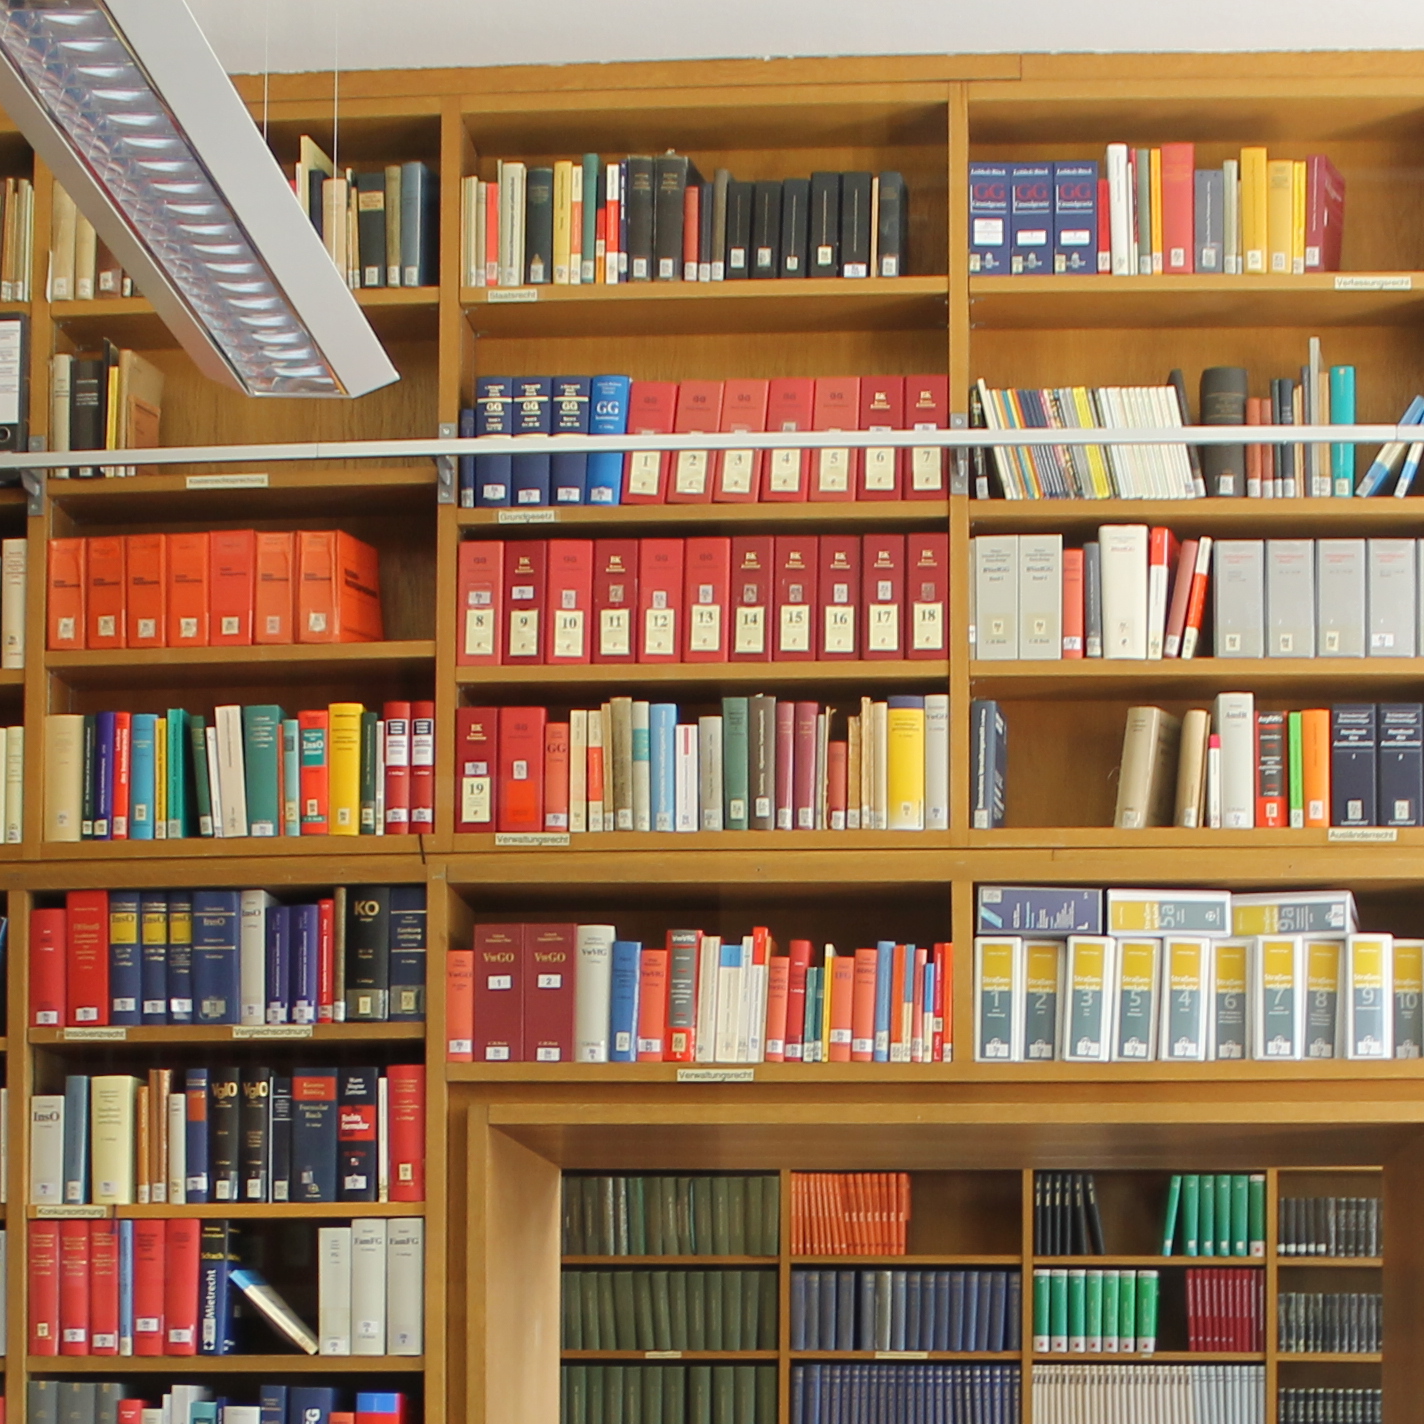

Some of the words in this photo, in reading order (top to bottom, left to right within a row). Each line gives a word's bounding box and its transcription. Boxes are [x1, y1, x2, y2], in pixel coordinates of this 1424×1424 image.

[975, 183, 1006, 199] GG
[1018, 183, 1048, 199] GG
[1060, 183, 1091, 199] GG
[1336, 277, 1410, 290] Verfassungsrecht
[489, 290, 537, 300] Staatsrecht
[596, 400, 620, 414] GG
[642, 455, 649, 467] 1
[689, 455, 697, 466] 2
[734, 454, 742, 466] 3
[781, 452, 790, 463] 4
[830, 452, 837, 464] 5
[876, 451, 884, 462] 6
[923, 451, 930, 462] 7
[500, 511, 553, 523] Grundgesetz
[476, 616, 484, 628] 8
[608, 616, 622, 628] 11
[653, 615, 668, 627] 12
[698, 612, 713, 624] 13
[743, 613, 758, 626] 14
[787, 611, 803, 624] 15
[832, 613, 847, 625] 16
[877, 611, 892, 623] 17
[921, 609, 936, 622] 18
[520, 617, 528, 628] 9
[562, 617, 577, 629] 10
[546, 742, 567, 754] GG
[469, 783, 484, 796] 19
[496, 835, 569, 846] Verwaltungsrecht
[1329, 829, 1395, 839] Ausländerrecht
[354, 900, 380, 917] KO
[482, 951, 515, 964] VwGO
[533, 951, 566, 964] VwGO
[992, 991, 999, 1007] 1
[1036, 994, 1047, 1007] 2
[1080, 990, 1092, 1006] 3
[1130, 990, 1142, 1007] 5
[1178, 990, 1191, 1006] 4
[1224, 993, 1236, 1008] 6
[1273, 987, 1286, 1004] 7
[1315, 991, 1327, 1007] 8
[1361, 987, 1374, 1005] 9
[1396, 991, 1417, 1009] 10
[234, 1026, 312, 1038] Vergleichsordnung
[678, 1070, 753, 1082] Verwaltungsrecht
[211, 1082, 237, 1099] VglO
[243, 1081, 268, 1099] VglO
[33, 1111, 60, 1122] InsO
[38, 1205, 105, 1218] Konkursordnung
[204, 1269, 217, 1320] Mietrecht
